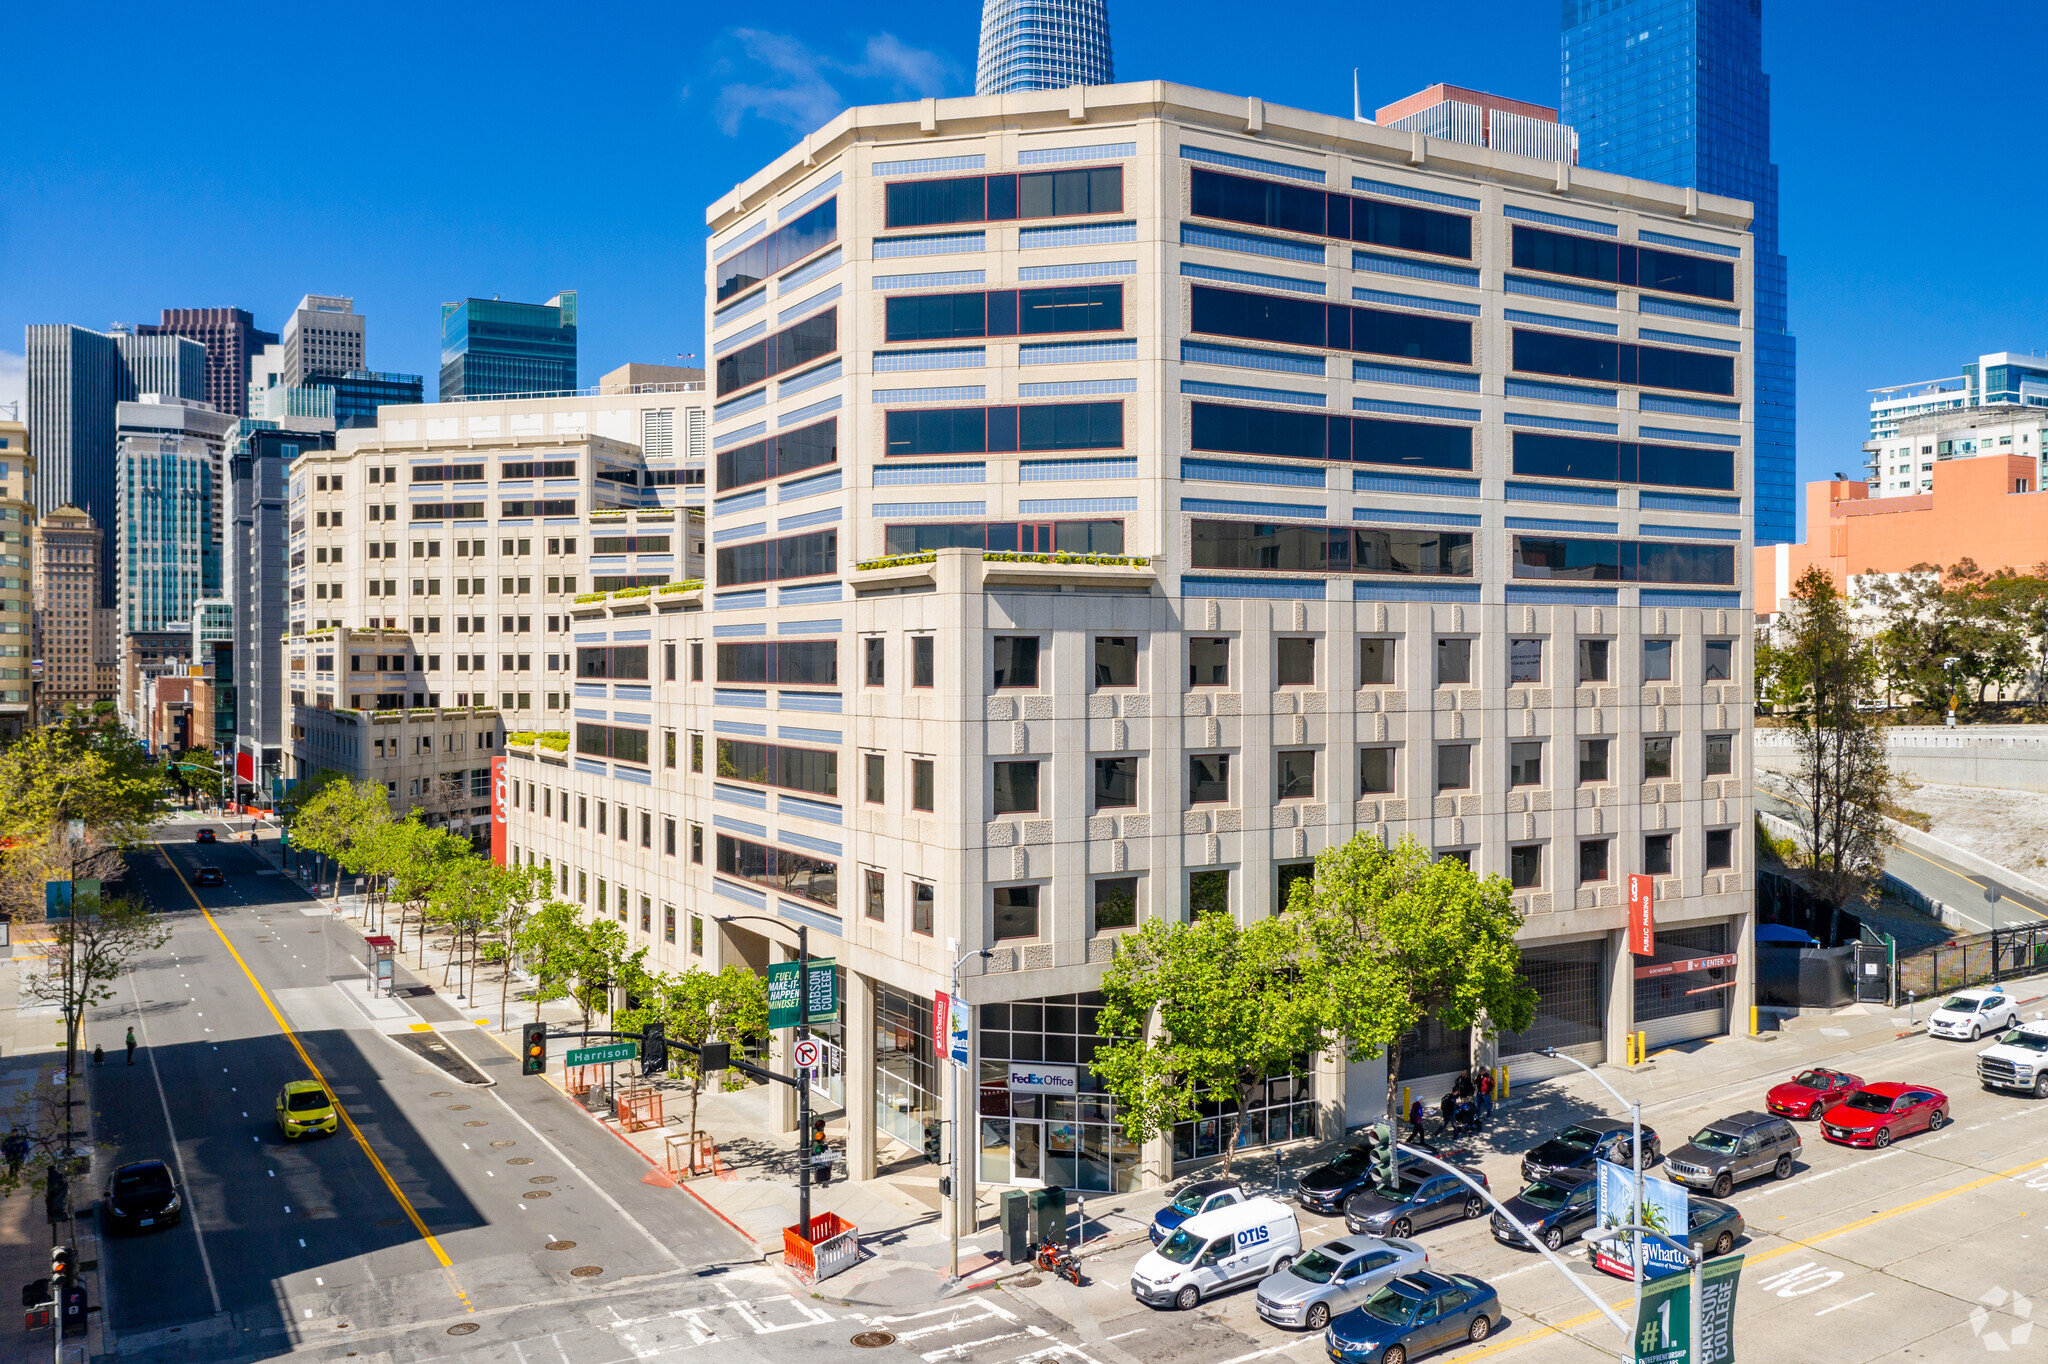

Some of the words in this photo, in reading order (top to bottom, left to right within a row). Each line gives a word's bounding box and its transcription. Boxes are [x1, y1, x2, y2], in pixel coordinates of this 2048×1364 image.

[495, 762, 507, 823] 303
[1707, 958, 1724, 967] ENTER
[775, 972, 792, 981] FUEL
[794, 970, 800, 980] A
[768, 980, 799, 991] MAKE-IT-
[809, 970, 821, 1012] BABSON
[821, 969, 833, 1011] COLLEGE
[770, 989, 800, 1001] HAPPEN
[768, 998, 800, 1010] MINDSET
[574, 1049, 629, 1062] Harrison
[1012, 1072, 1044, 1085] FedEx
[1044, 1074, 1074, 1087] Office
[815, 1154, 839, 1162] Harrison
[1600, 1163, 1608, 1212] EXECUTIVES
[1237, 1225, 1269, 1245] OTIS
[1704, 1269, 1714, 1277] SAN
[1714, 1263, 1738, 1275] FRANCISCO
[1647, 1286, 1658, 1294] SAN
[1658, 1278, 1684, 1289] FRANCISCO
[1757, 1262, 1845, 1298] NO
[1702, 1283, 1719, 1364] BABSON
[1713, 1278, 1734, 1361] COLLEGE
[1638, 1349, 1687, 1364] ENTREPRENEURSHIP
